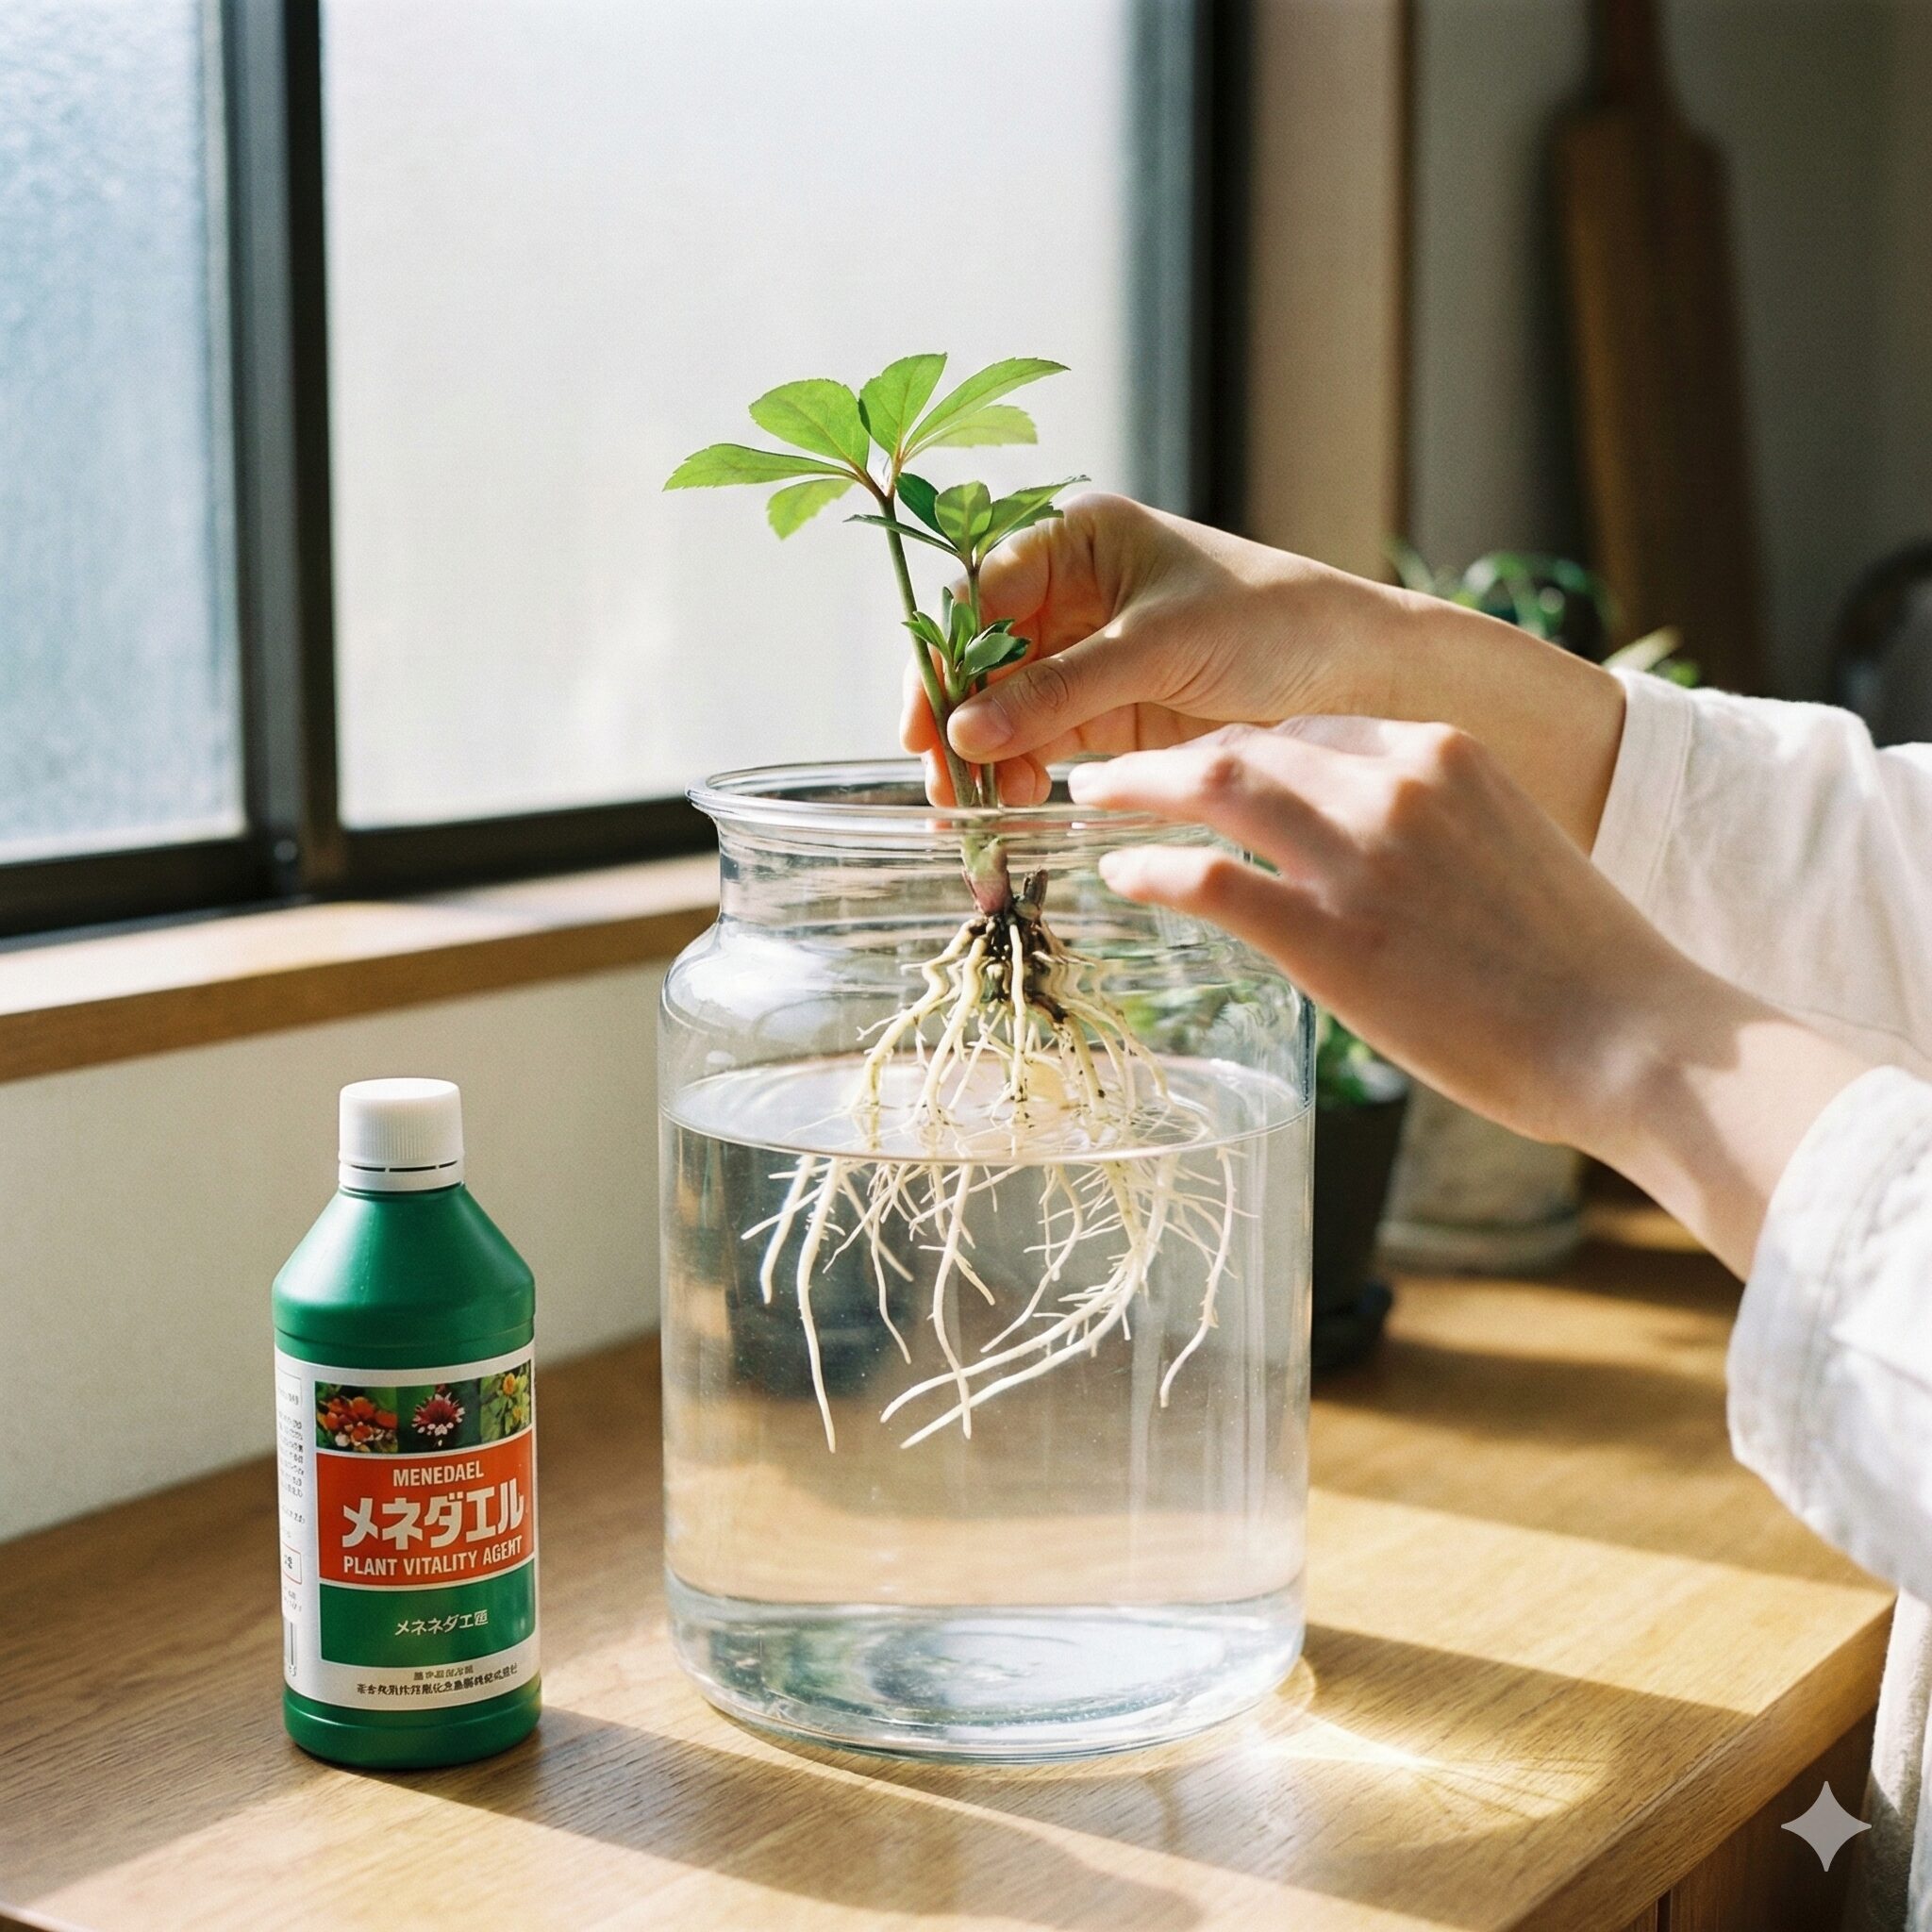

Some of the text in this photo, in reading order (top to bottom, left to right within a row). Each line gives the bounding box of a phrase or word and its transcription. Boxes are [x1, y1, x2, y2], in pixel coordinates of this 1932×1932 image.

[392, 1460, 484, 1487] MENEDAEL
[341, 1477, 525, 1550] メネダエル
[343, 1556, 397, 1576] PLANT
[403, 1550, 477, 1576] VITALITY
